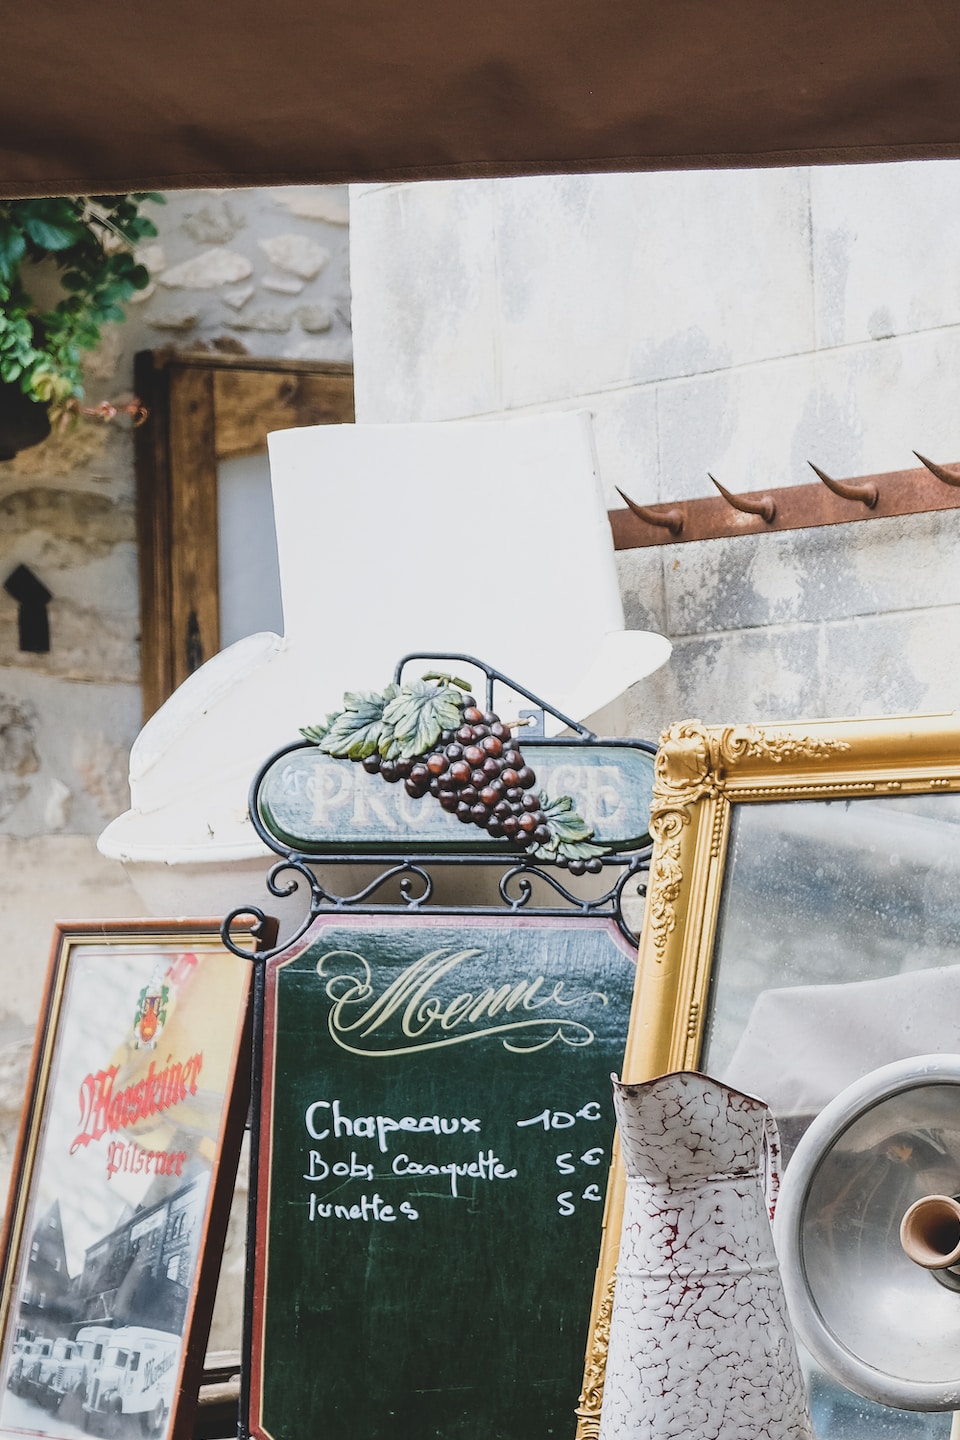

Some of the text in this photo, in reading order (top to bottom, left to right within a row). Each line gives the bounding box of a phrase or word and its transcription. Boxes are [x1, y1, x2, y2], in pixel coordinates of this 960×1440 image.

[316, 949, 608, 1052] Menu
[305, 1099, 481, 1152] Chapeaux
[107, 1140, 187, 1181] Pilsener
[555, 1148, 604, 1175] 5€
